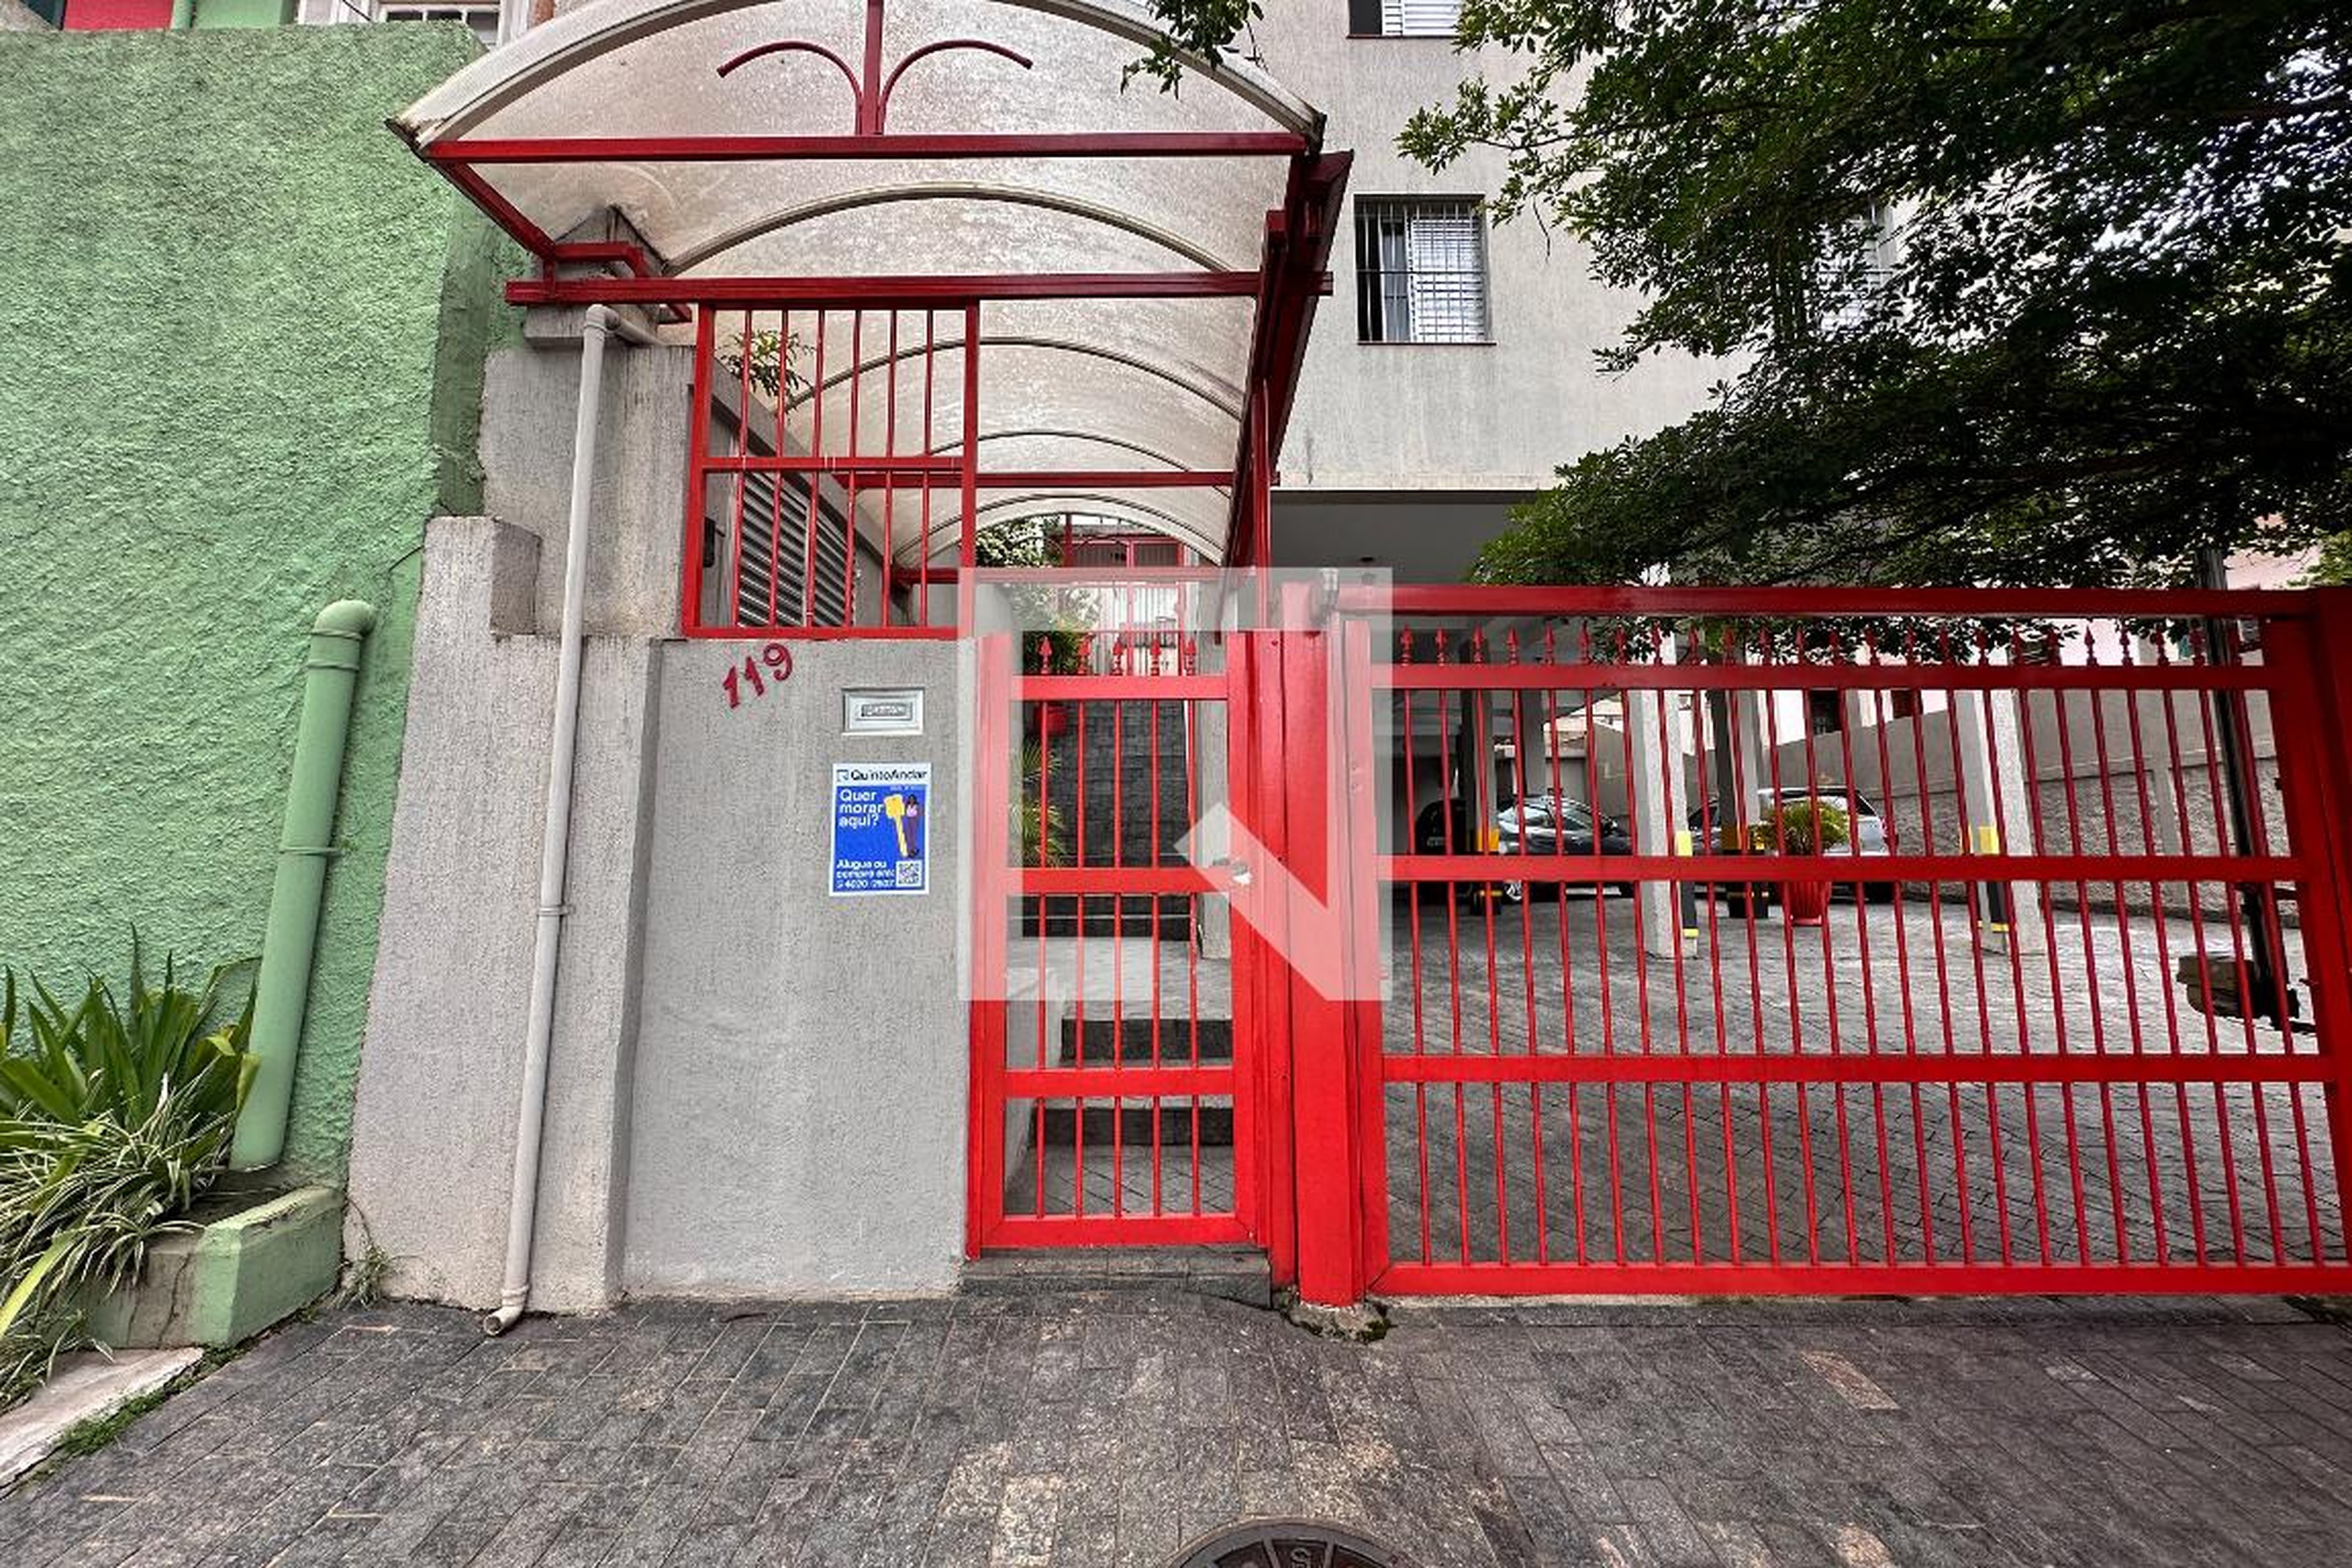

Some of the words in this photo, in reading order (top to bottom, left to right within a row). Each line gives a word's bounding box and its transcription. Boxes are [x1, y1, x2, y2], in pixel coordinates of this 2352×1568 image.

[723, 643, 793, 709] 119
[851, 769, 927, 781] QuintoAndar
[840, 788, 877, 802] Quer
[839, 803, 883, 813] morar
[839, 815, 879, 829] aqui?
